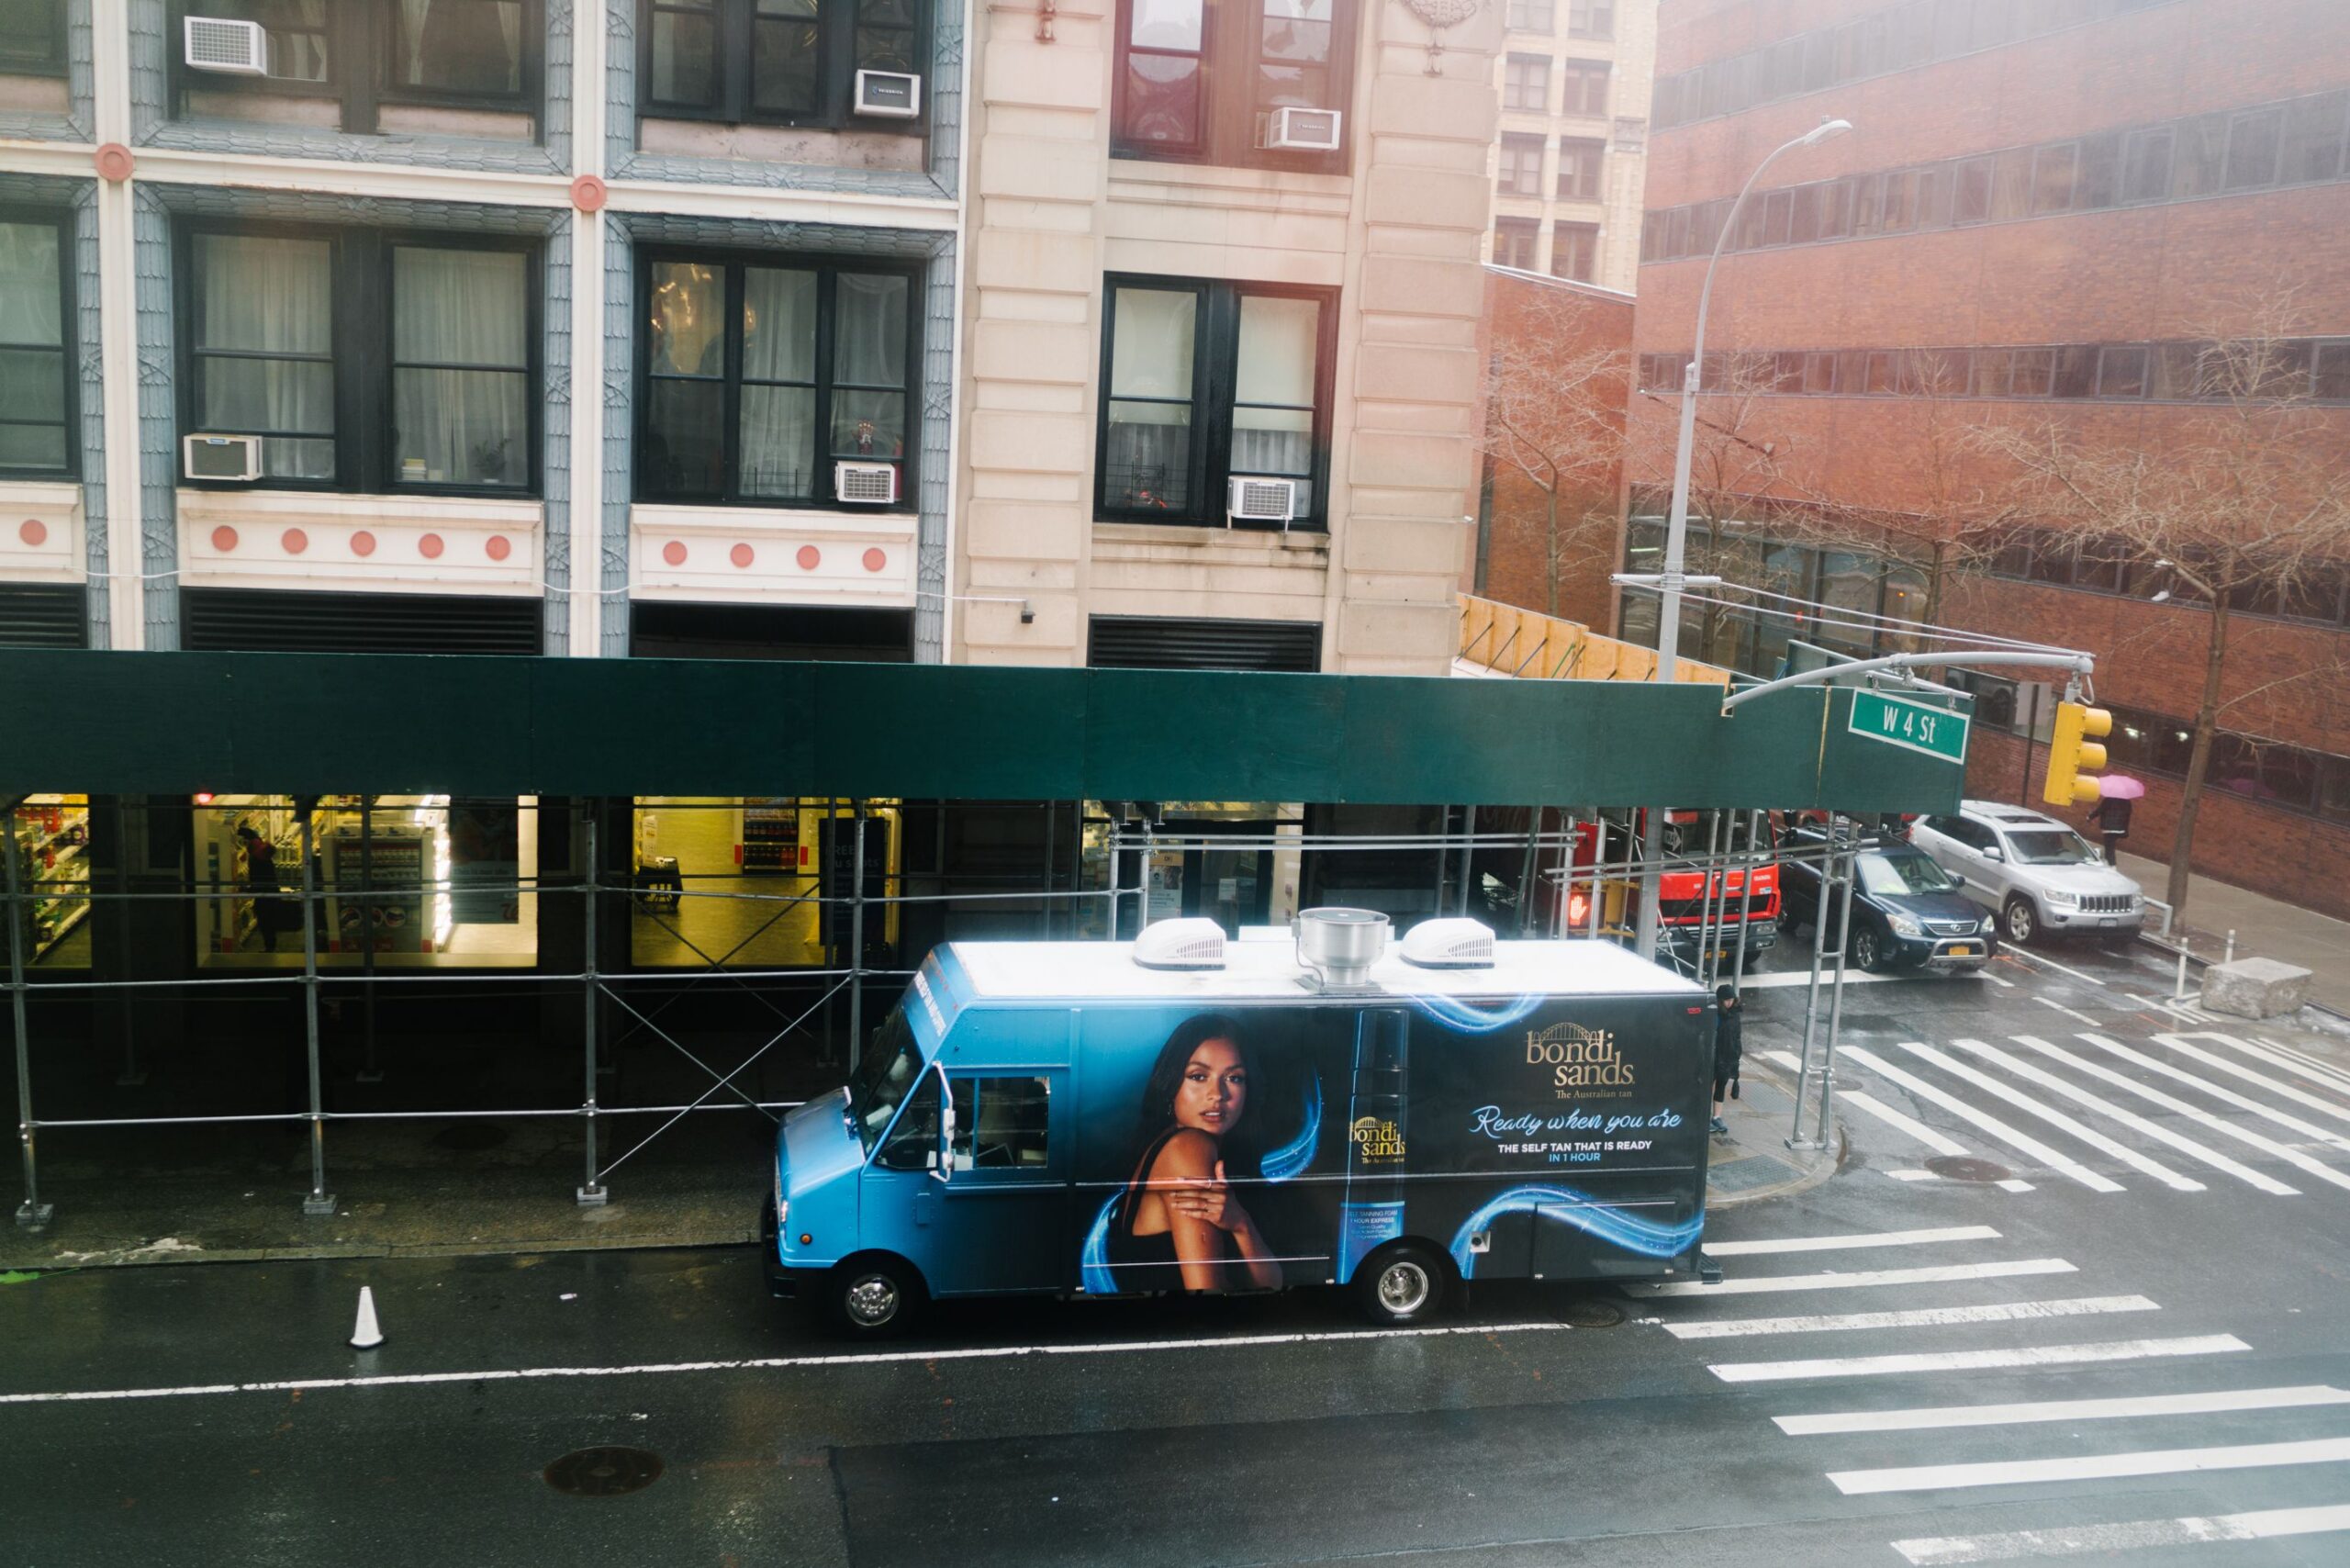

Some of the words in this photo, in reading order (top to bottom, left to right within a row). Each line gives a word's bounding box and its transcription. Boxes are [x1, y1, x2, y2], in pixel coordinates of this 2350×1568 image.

[1884, 705, 1898, 733] W
[1903, 711, 1914, 737] 4
[1919, 715, 1936, 744] St
[1527, 1028, 1614, 1064] bondi
[1554, 1050, 1634, 1086] sands
[1555, 1090, 1572, 1099] The
[1573, 1090, 1616, 1099] Australian
[1618, 1090, 1632, 1098] tan
[1349, 1121, 1397, 1142] bondi
[1469, 1105, 1543, 1138] Ready
[1548, 1108, 1603, 1130] when
[1604, 1114, 1644, 1134] you
[1648, 1108, 1682, 1128] are
[1361, 1133, 1405, 1156] sands
[1498, 1144, 1519, 1154] THE
[1522, 1143, 1548, 1153] SELF
[1550, 1142, 1572, 1152] TAN
[1574, 1142, 1602, 1152] THAT
[1604, 1141, 1614, 1151] IS
[1617, 1140, 1652, 1150] READY
[1549, 1154, 1561, 1162] IN
[1570, 1152, 1601, 1161] HOUR
